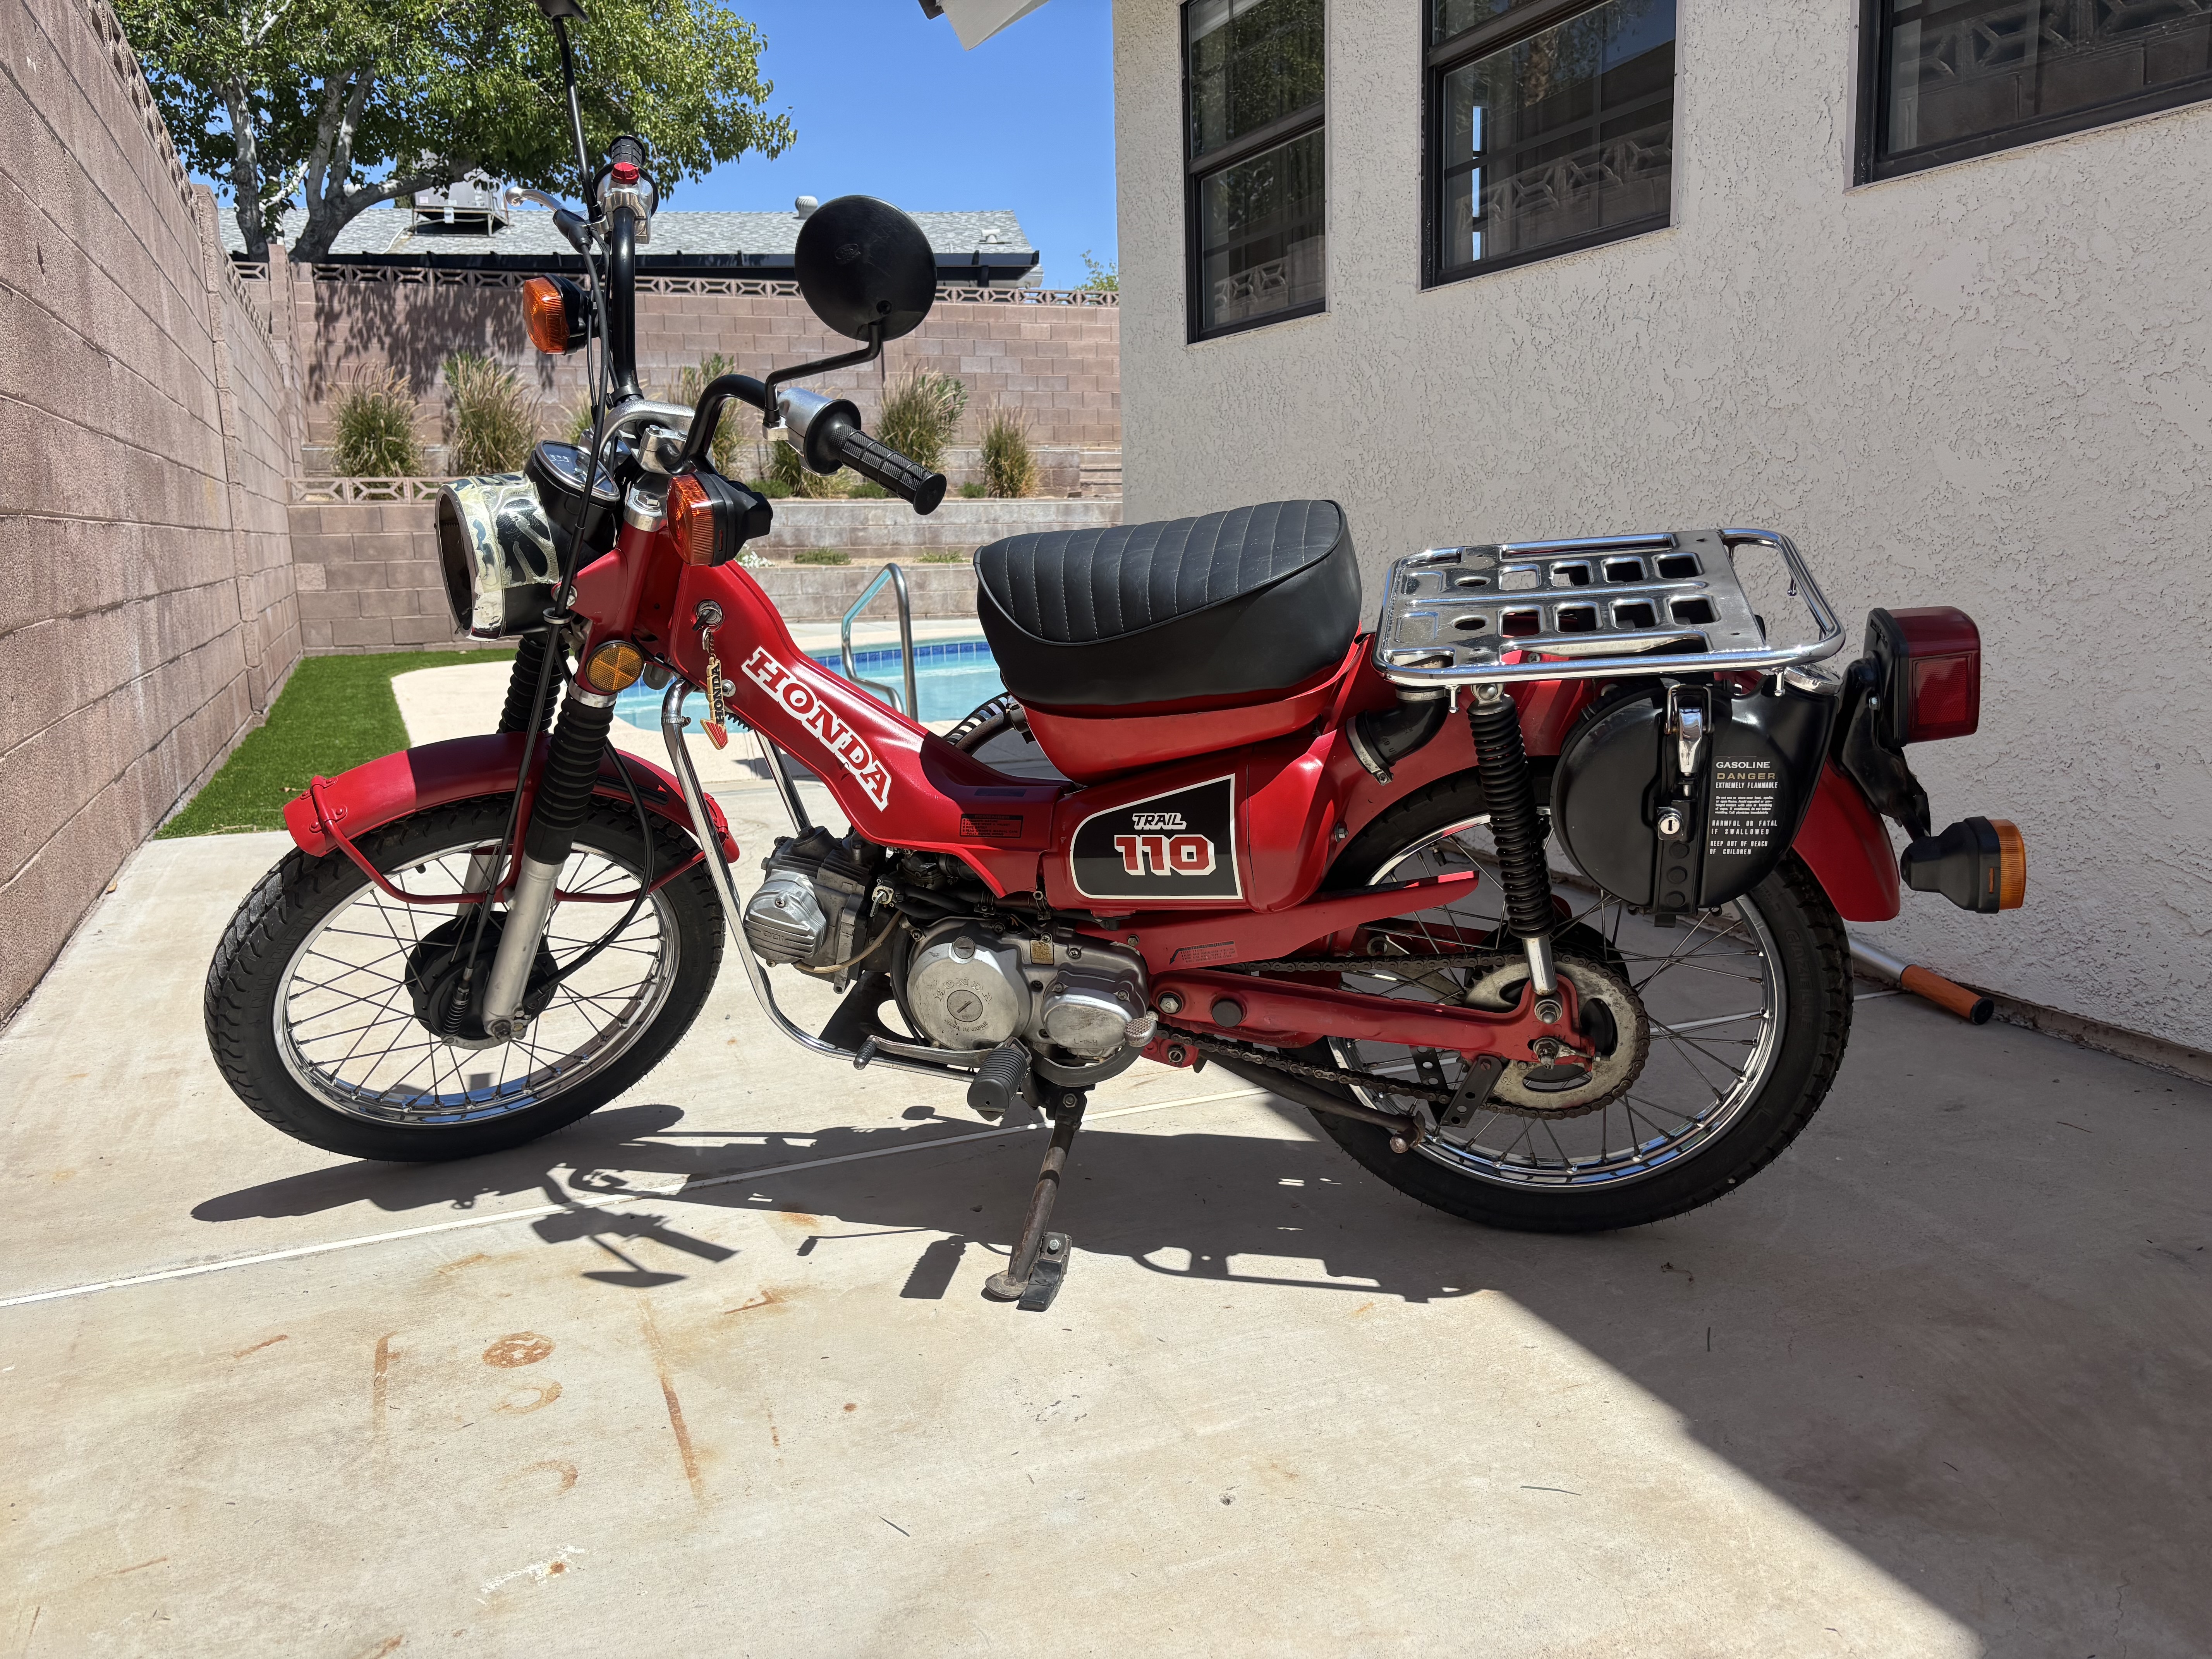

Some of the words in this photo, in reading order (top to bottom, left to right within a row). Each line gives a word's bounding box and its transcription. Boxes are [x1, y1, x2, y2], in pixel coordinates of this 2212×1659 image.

[711, 663, 725, 725] HONDA
[742, 647, 891, 810] HONDA
[1132, 813, 1187, 830] TRAIL
[1114, 835, 1216, 876] 110
[249, 888, 348, 1009] MICHELIN
[763, 930, 784, 942] CDI
[934, 978, 992, 1004] HONDA
[1784, 929, 1813, 1029] GAZELLE
